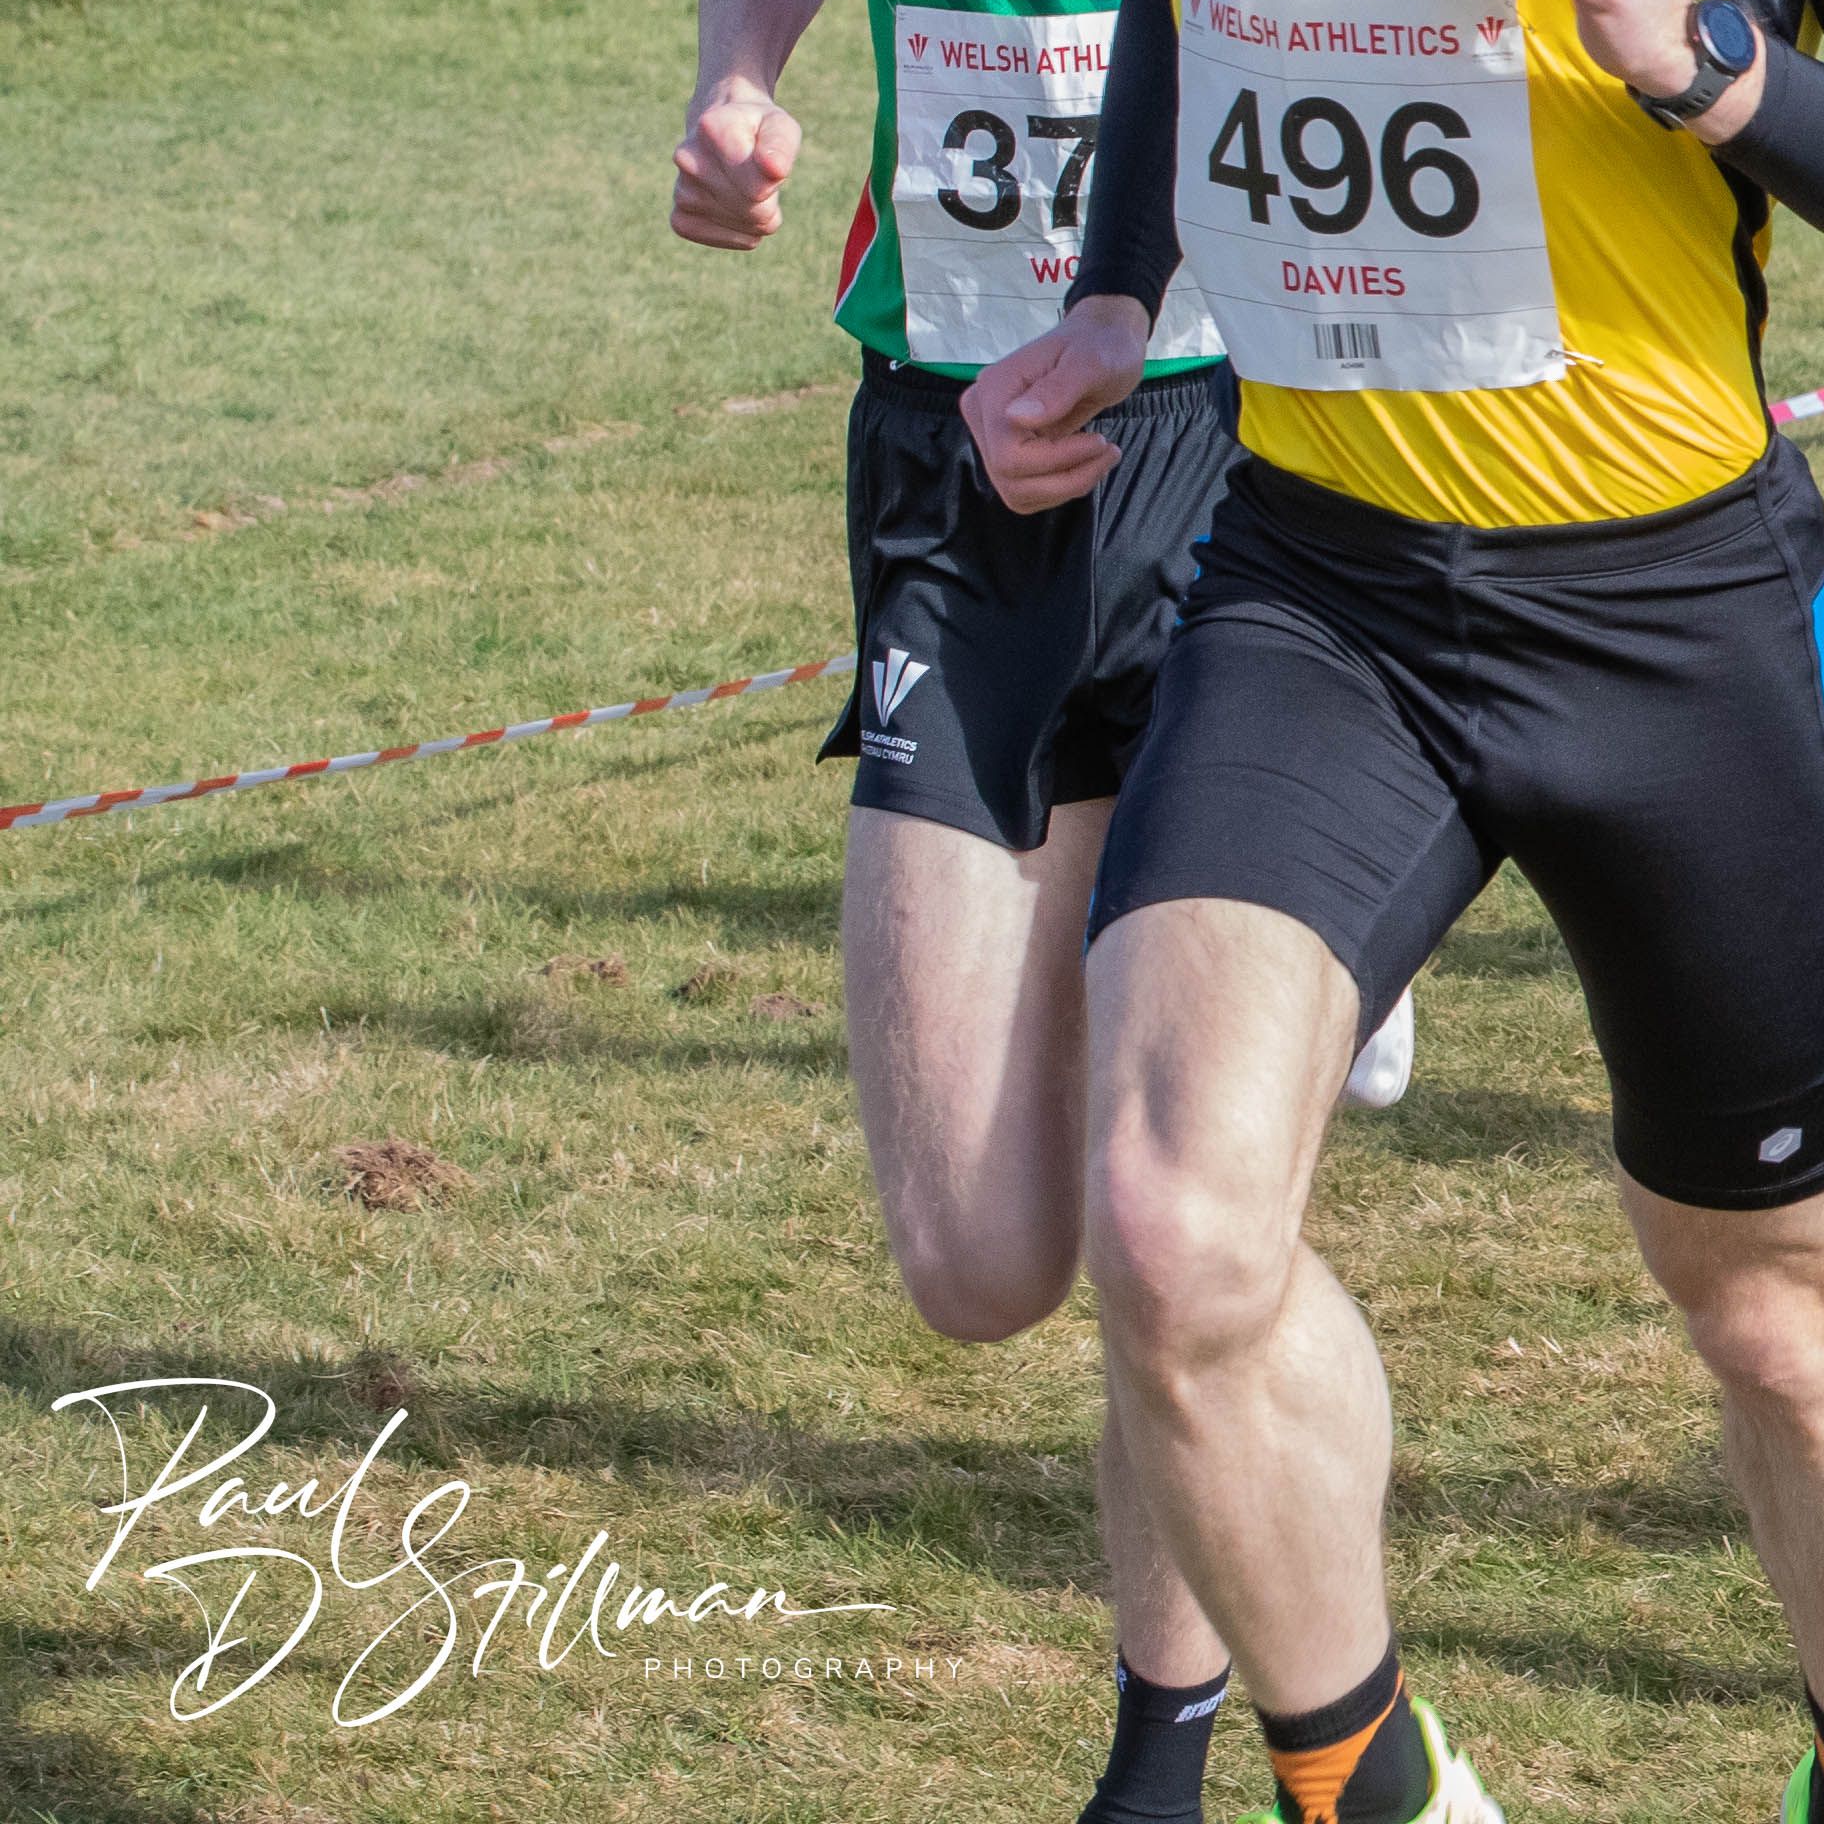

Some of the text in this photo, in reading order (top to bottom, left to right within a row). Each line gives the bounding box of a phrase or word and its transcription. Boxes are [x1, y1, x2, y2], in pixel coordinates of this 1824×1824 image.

[1209, 0, 1460, 57] WELSH ATHLETICS
[940, 40, 1110, 75] WELSH ATHL
[937, 109, 1101, 231] 37
[1208, 87, 1480, 238] 496
[1281, 260, 1406, 297] DAVIES
[883, 748, 914, 764] CYMRU
